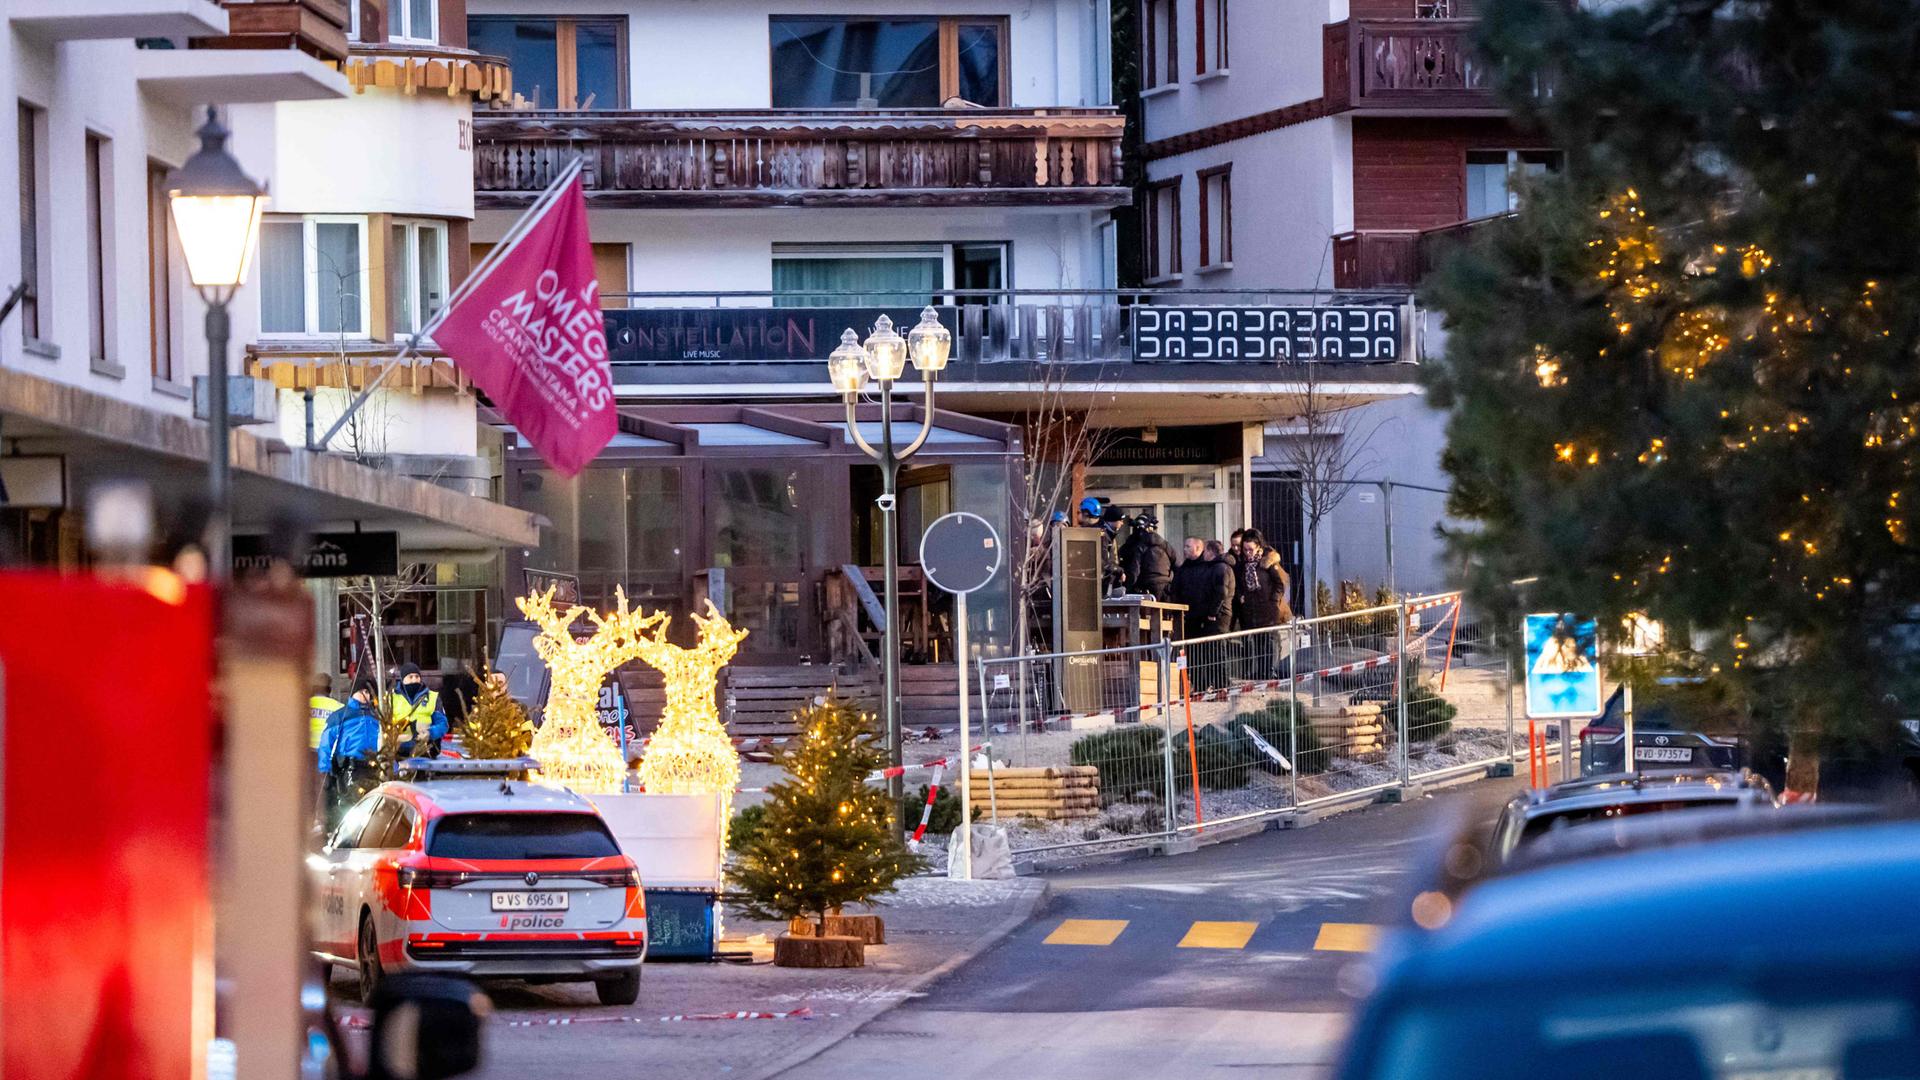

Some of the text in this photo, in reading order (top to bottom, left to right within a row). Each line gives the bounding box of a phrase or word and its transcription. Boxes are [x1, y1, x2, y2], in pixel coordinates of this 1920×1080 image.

[605, 317, 815, 354] ONSTELLATION
[501, 289, 612, 412] MASTERS
[683, 350, 720, 358] LIVE MUSIC
[301, 552, 349, 568] rans
[1657, 749, 1683, 759] 97357
[507, 894, 554, 906] VS 6956
[511, 915, 564, 930] police
